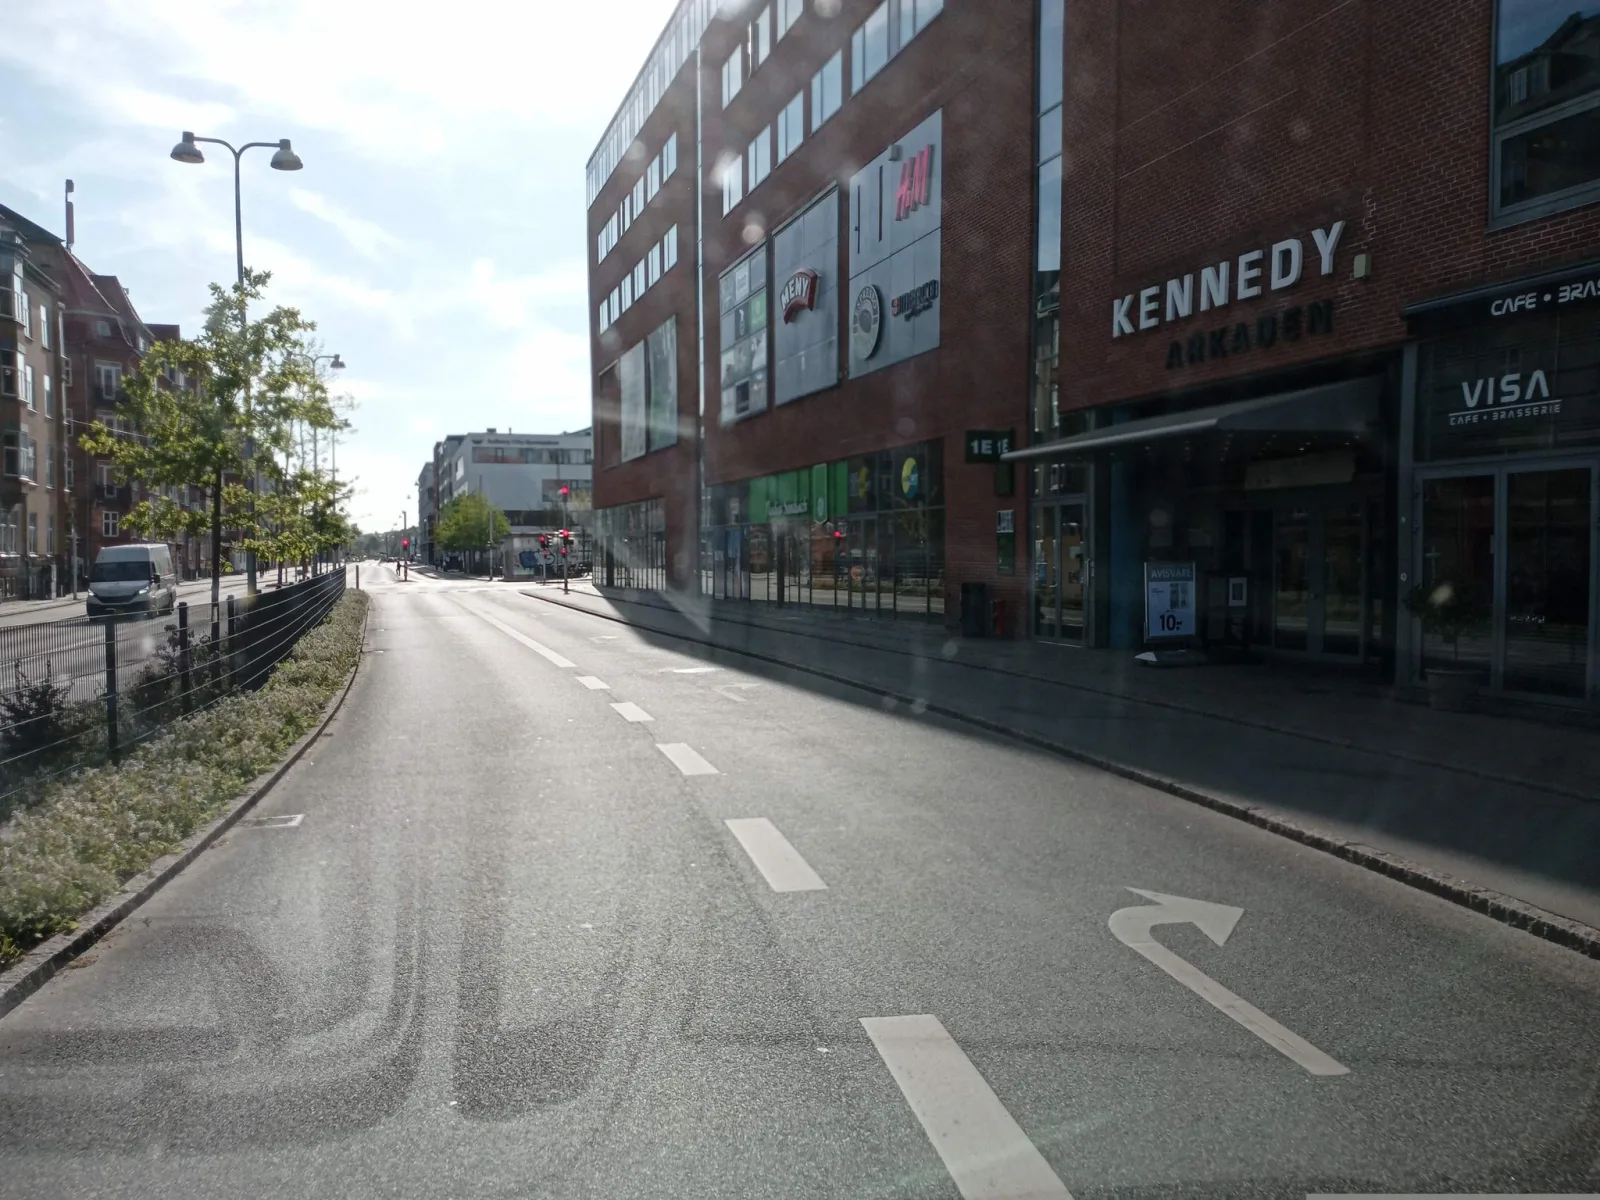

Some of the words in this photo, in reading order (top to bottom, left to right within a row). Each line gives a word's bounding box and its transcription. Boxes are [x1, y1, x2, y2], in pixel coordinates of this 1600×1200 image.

[781, 276, 809, 310] MENY
[1490, 292, 1537, 316] CAFE
[1461, 369, 1550, 408] VISA
[1449, 414, 1479, 426] CAFE
[1492, 404, 1561, 421] BRASSERIE
[970, 439, 993, 455] 1E
